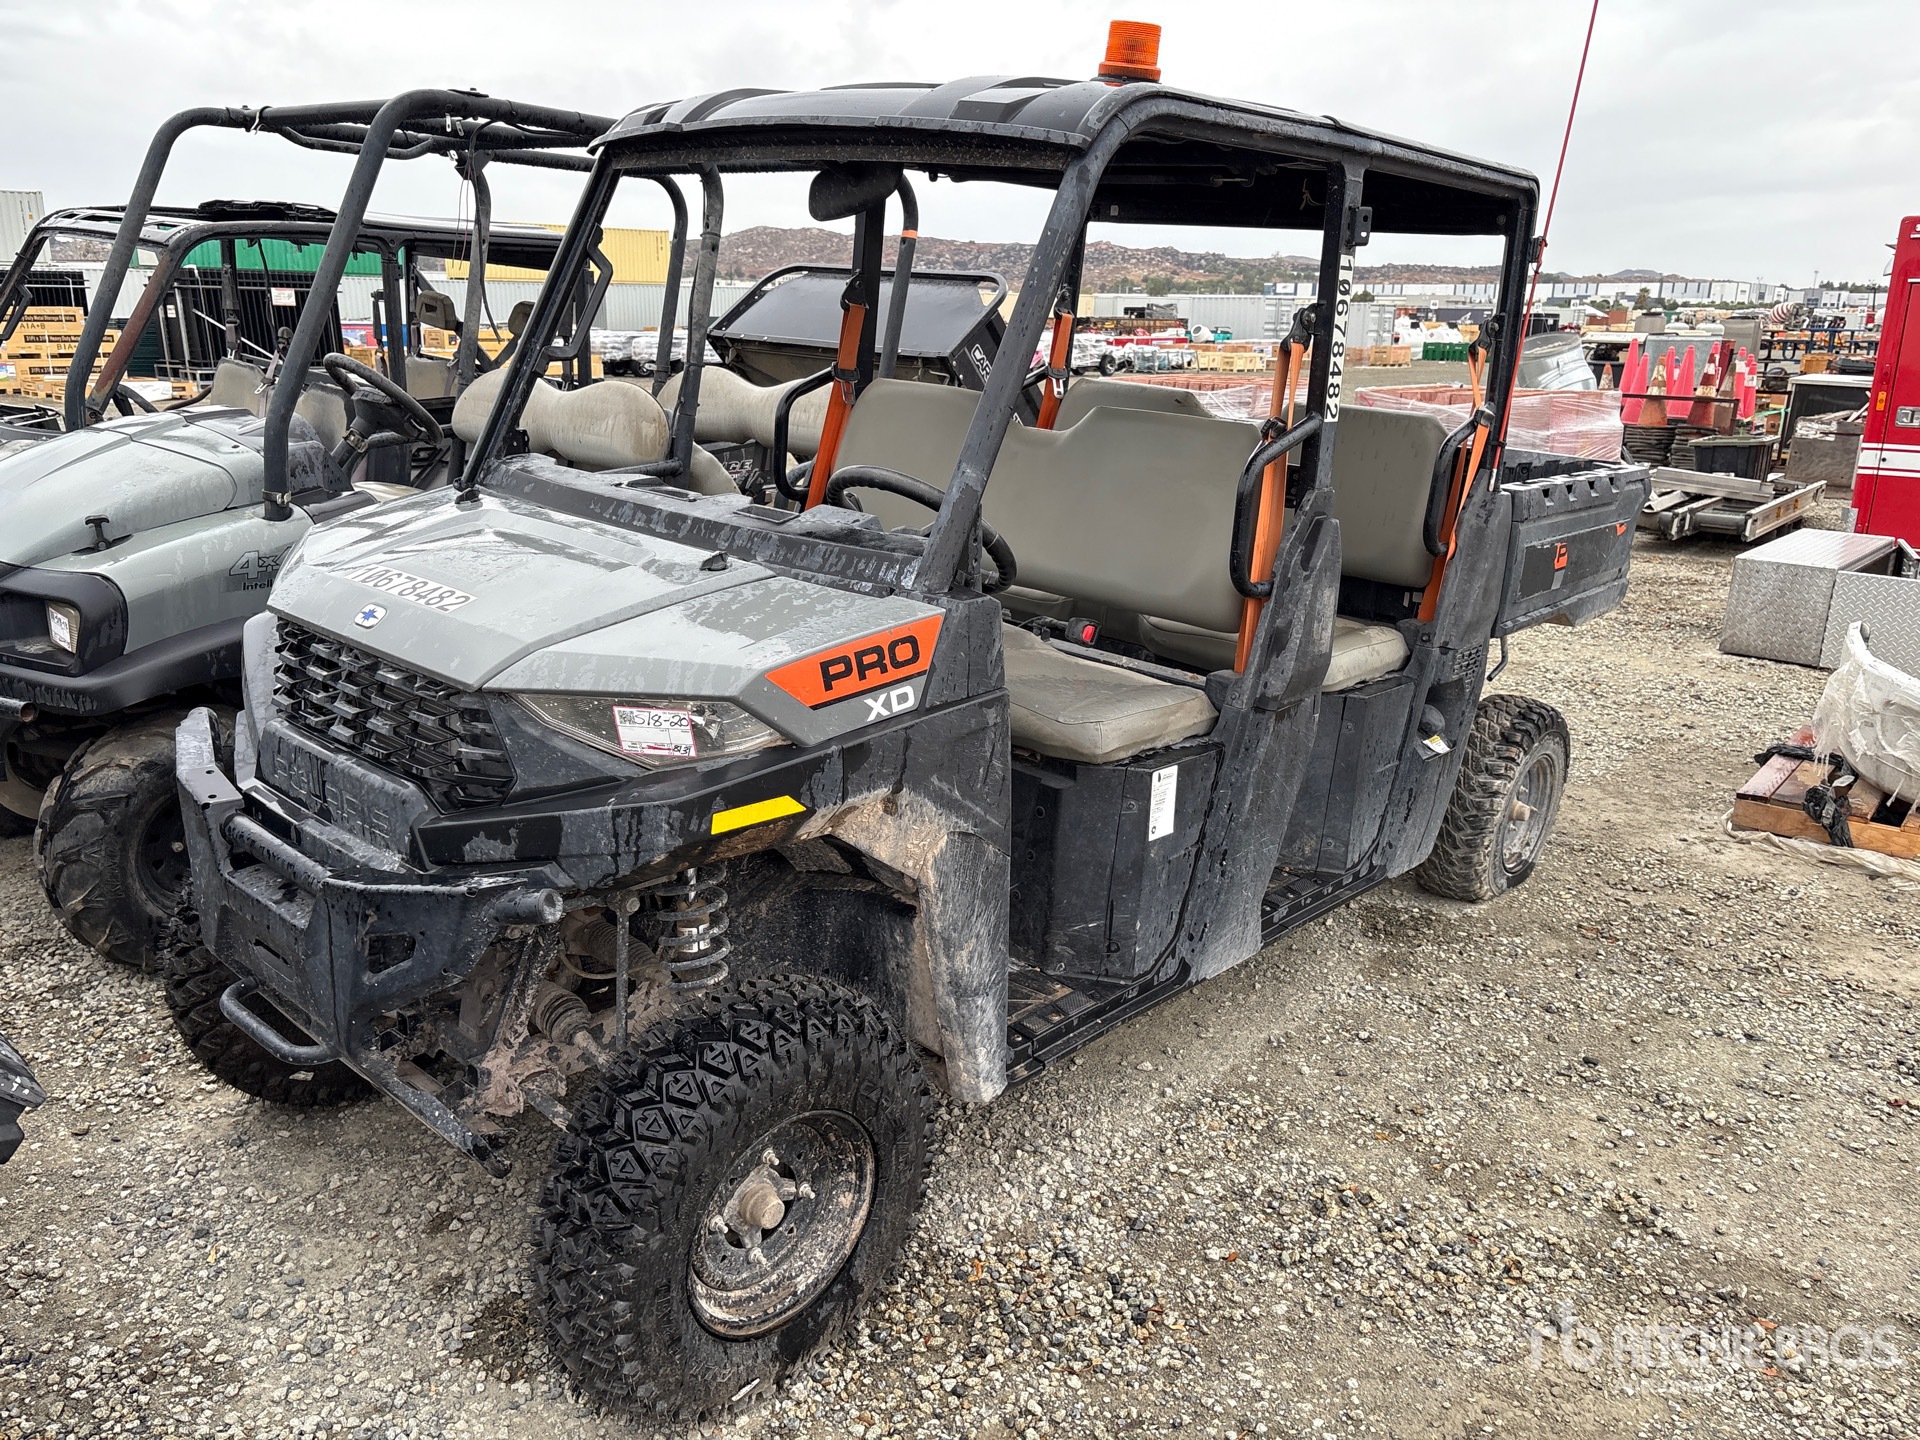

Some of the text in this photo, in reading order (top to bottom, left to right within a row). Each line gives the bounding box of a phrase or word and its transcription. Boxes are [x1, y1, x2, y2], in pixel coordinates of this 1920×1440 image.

[1325, 258, 1353, 420] 10678482
[351, 565, 472, 612] 10678482
[819, 635, 921, 692] PRO
[864, 685, 915, 722] XD
